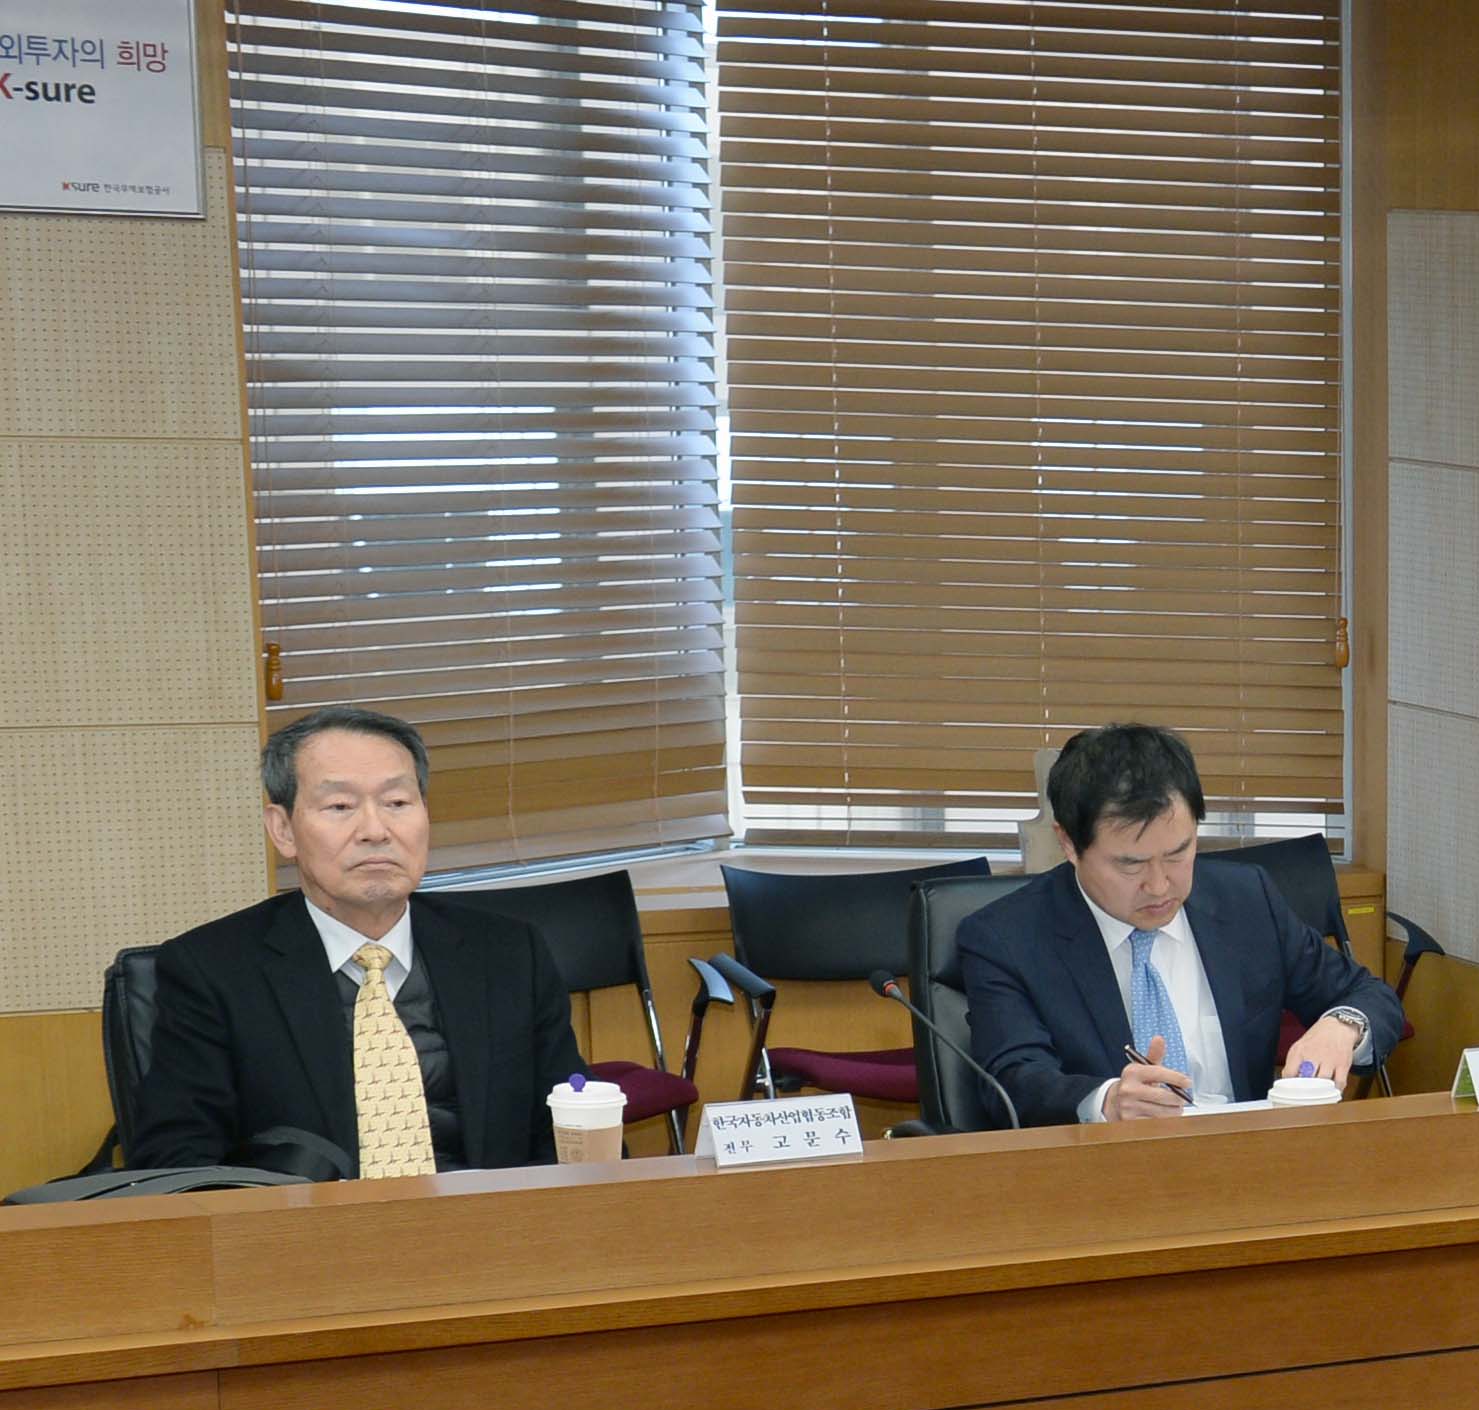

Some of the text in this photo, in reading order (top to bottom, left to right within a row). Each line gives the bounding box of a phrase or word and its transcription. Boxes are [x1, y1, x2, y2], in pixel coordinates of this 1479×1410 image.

[0, 34, 169, 74] 외투자의 희망
[713, 1105, 852, 1131] 한국자동차산업협동조합
[772, 1127, 852, 1150] 고문수
